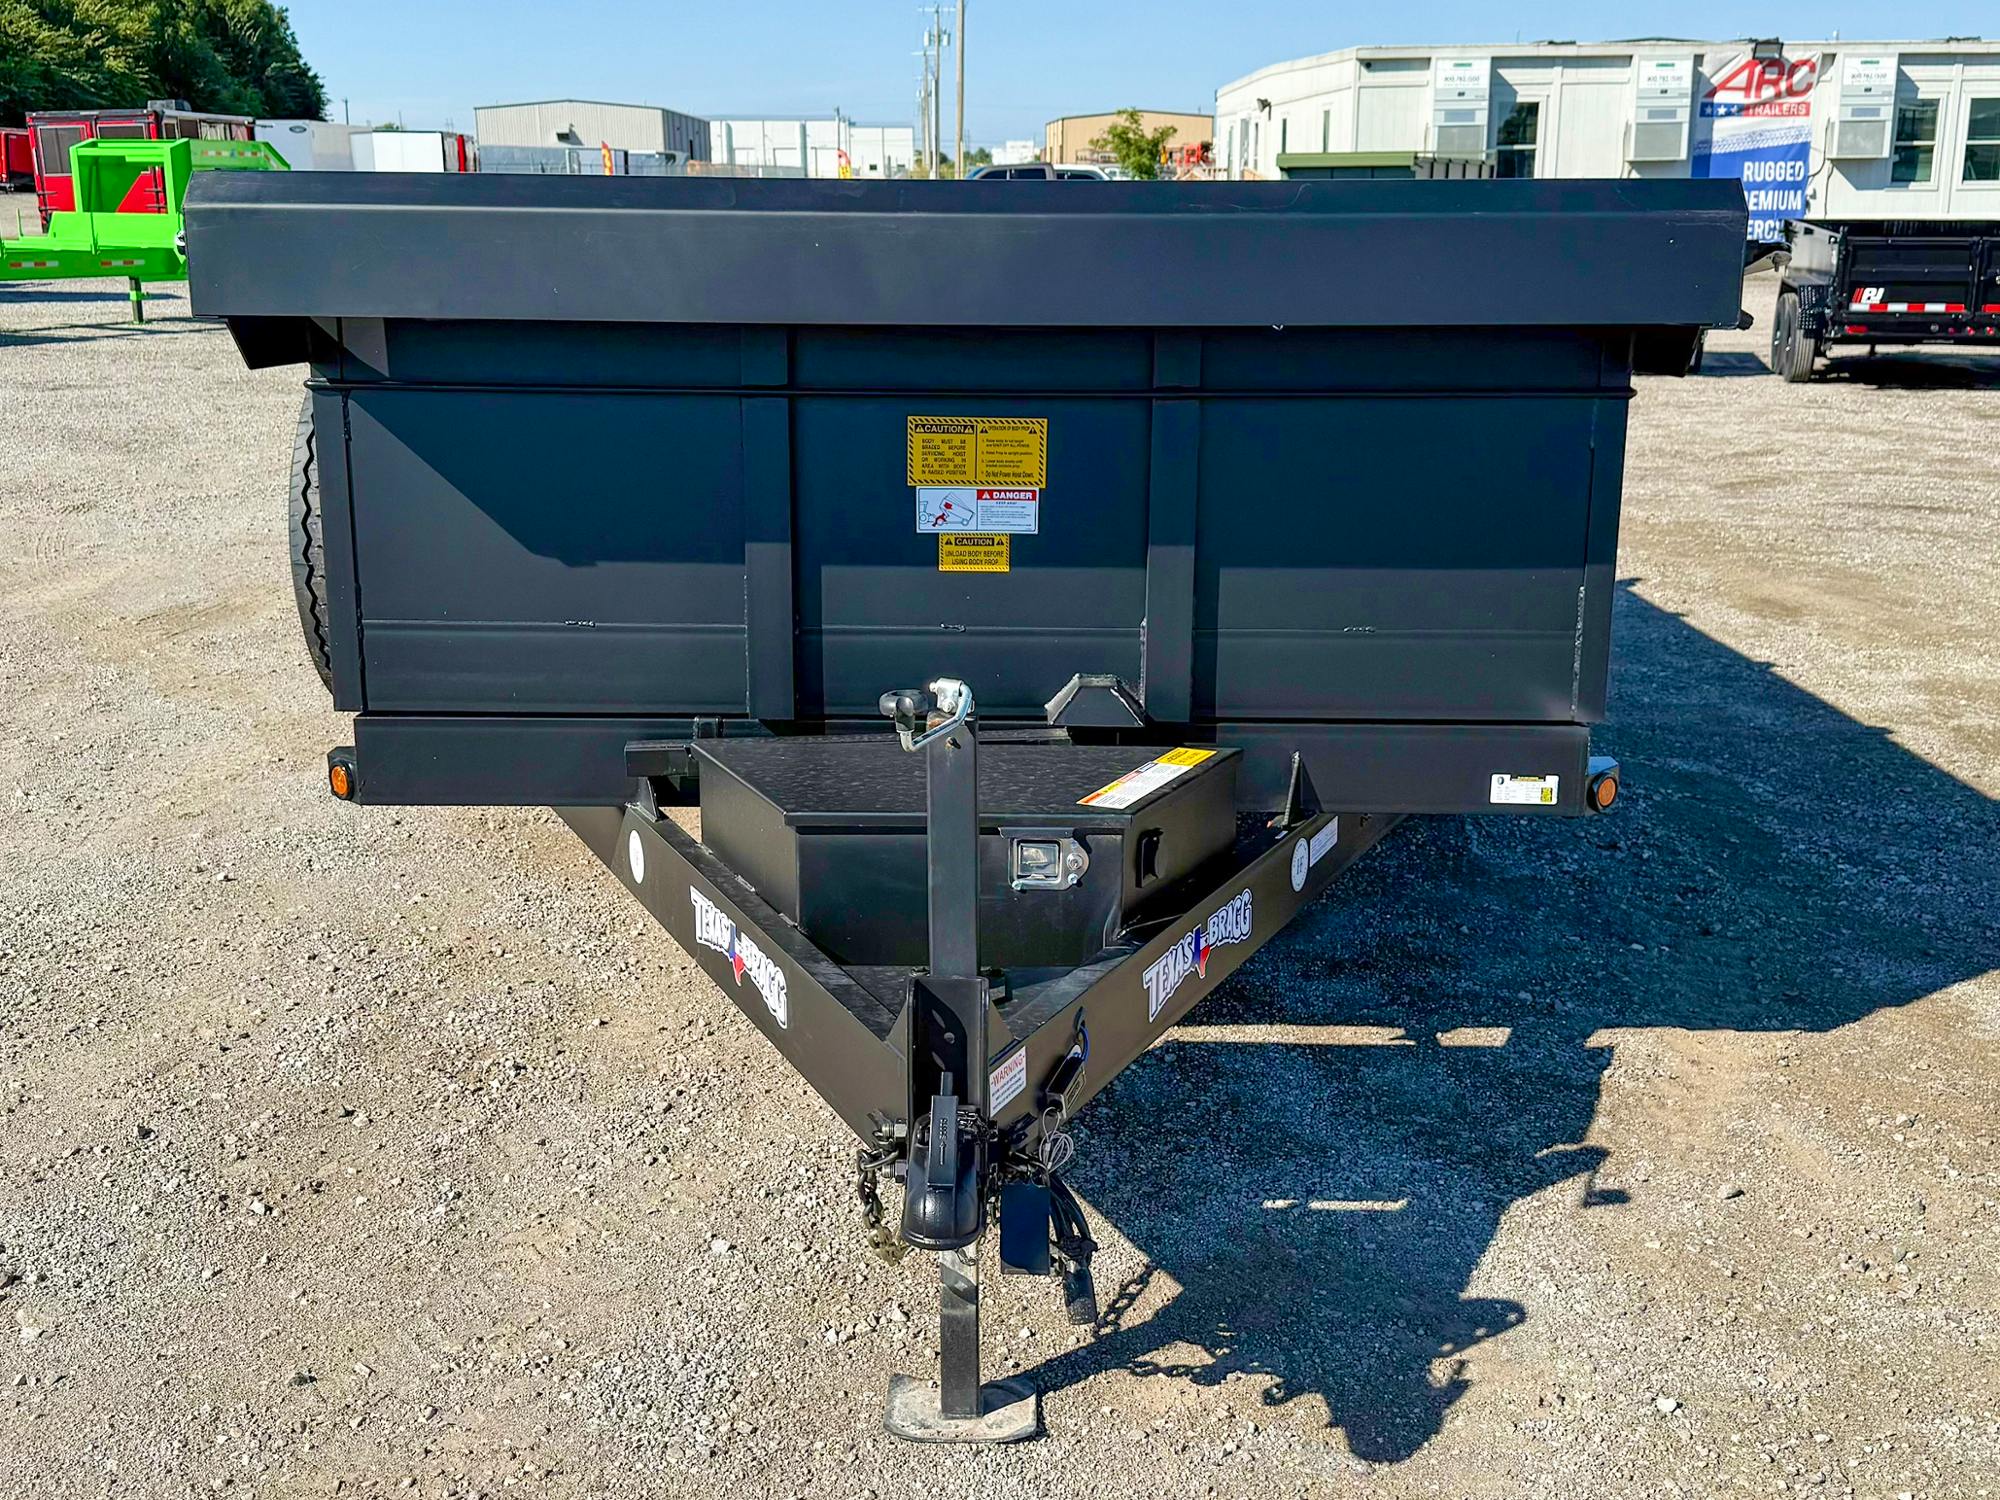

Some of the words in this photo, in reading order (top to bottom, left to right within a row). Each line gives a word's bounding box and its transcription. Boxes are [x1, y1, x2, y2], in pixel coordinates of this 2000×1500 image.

[1702, 58, 1817, 99] ARC
[1749, 102, 1807, 116] TRAILERS
[1743, 161, 1804, 182] RUGGED
[1744, 190, 1802, 211] EMIUM
[924, 425, 965, 433] CAUTION
[690, 885, 731, 953] TEXAS
[739, 932, 787, 1029] BRAGG
[1143, 932, 1195, 1022] TEXAS
[1207, 889, 1252, 946] BRAGG
